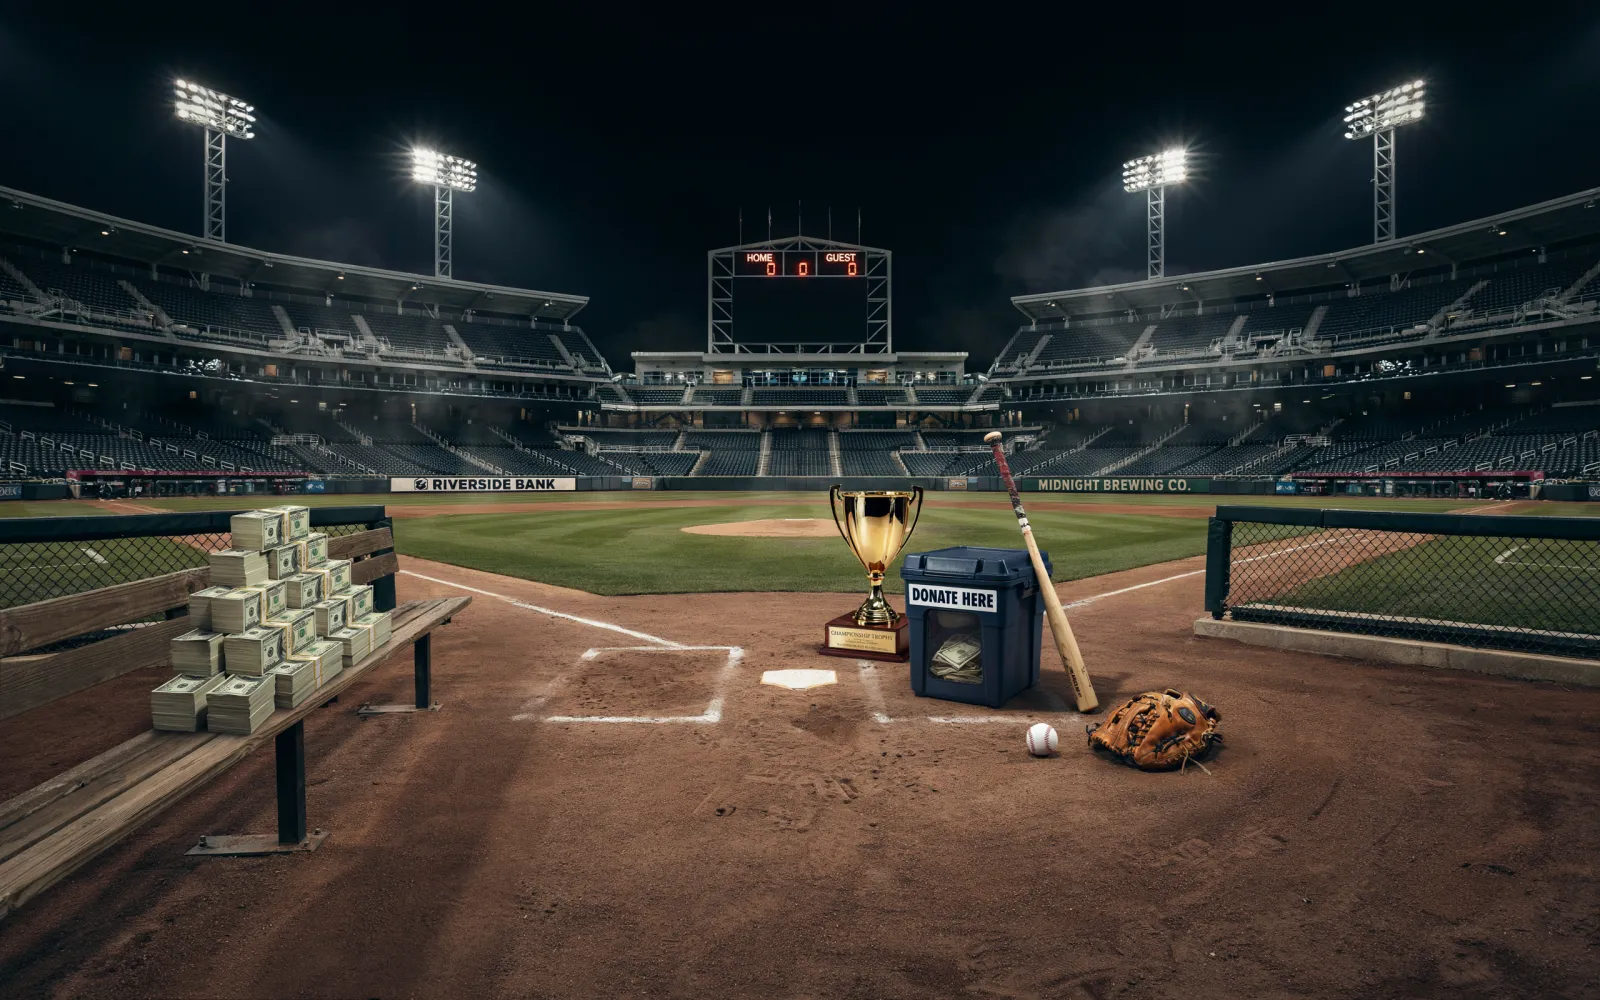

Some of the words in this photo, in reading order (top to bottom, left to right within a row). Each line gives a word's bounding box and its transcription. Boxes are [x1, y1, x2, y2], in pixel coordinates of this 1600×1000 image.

[747, 253, 773, 262] HOME
[826, 253, 856, 262] GUEST
[766, 262, 776, 276] 0
[799, 262, 808, 276] 0
[848, 262, 857, 276] 0
[433, 479, 511, 490] RIVERSIDE
[515, 478, 555, 490] BANK
[1038, 479, 1100, 491] MIDNIGHT
[1104, 479, 1164, 491] BREWING
[1168, 478, 1191, 491] CO.
[912, 587, 958, 605] DONATE
[962, 591, 994, 609] HERE
[830, 630, 871, 639] CHAMPIONSHIP
[871, 633, 893, 641] TROPHY
